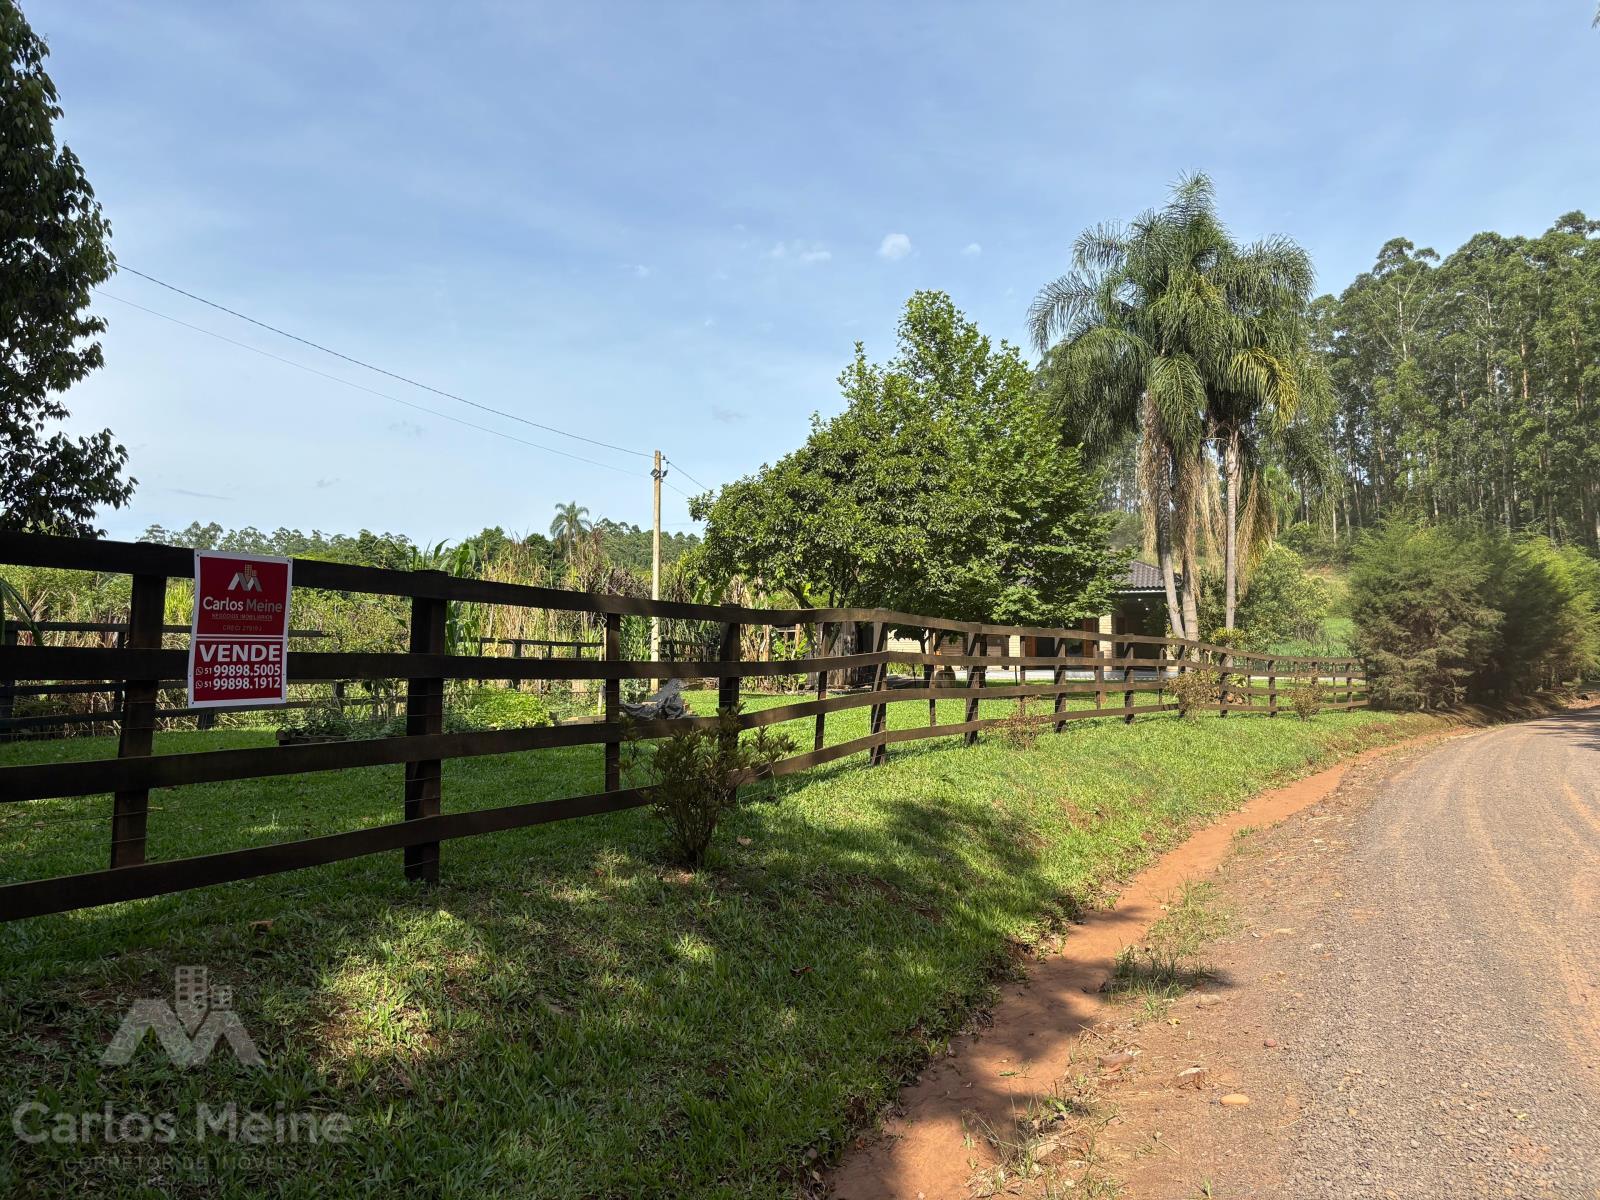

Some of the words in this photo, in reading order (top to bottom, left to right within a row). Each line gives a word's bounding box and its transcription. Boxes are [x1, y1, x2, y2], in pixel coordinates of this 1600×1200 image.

[203, 596, 244, 611] Carlos
[246, 598, 283, 613] Meine
[200, 644, 281, 662] VENDE
[204, 667, 212, 675] 51
[213, 664, 281, 677] 99898.5005
[213, 677, 281, 690] 99898.1912
